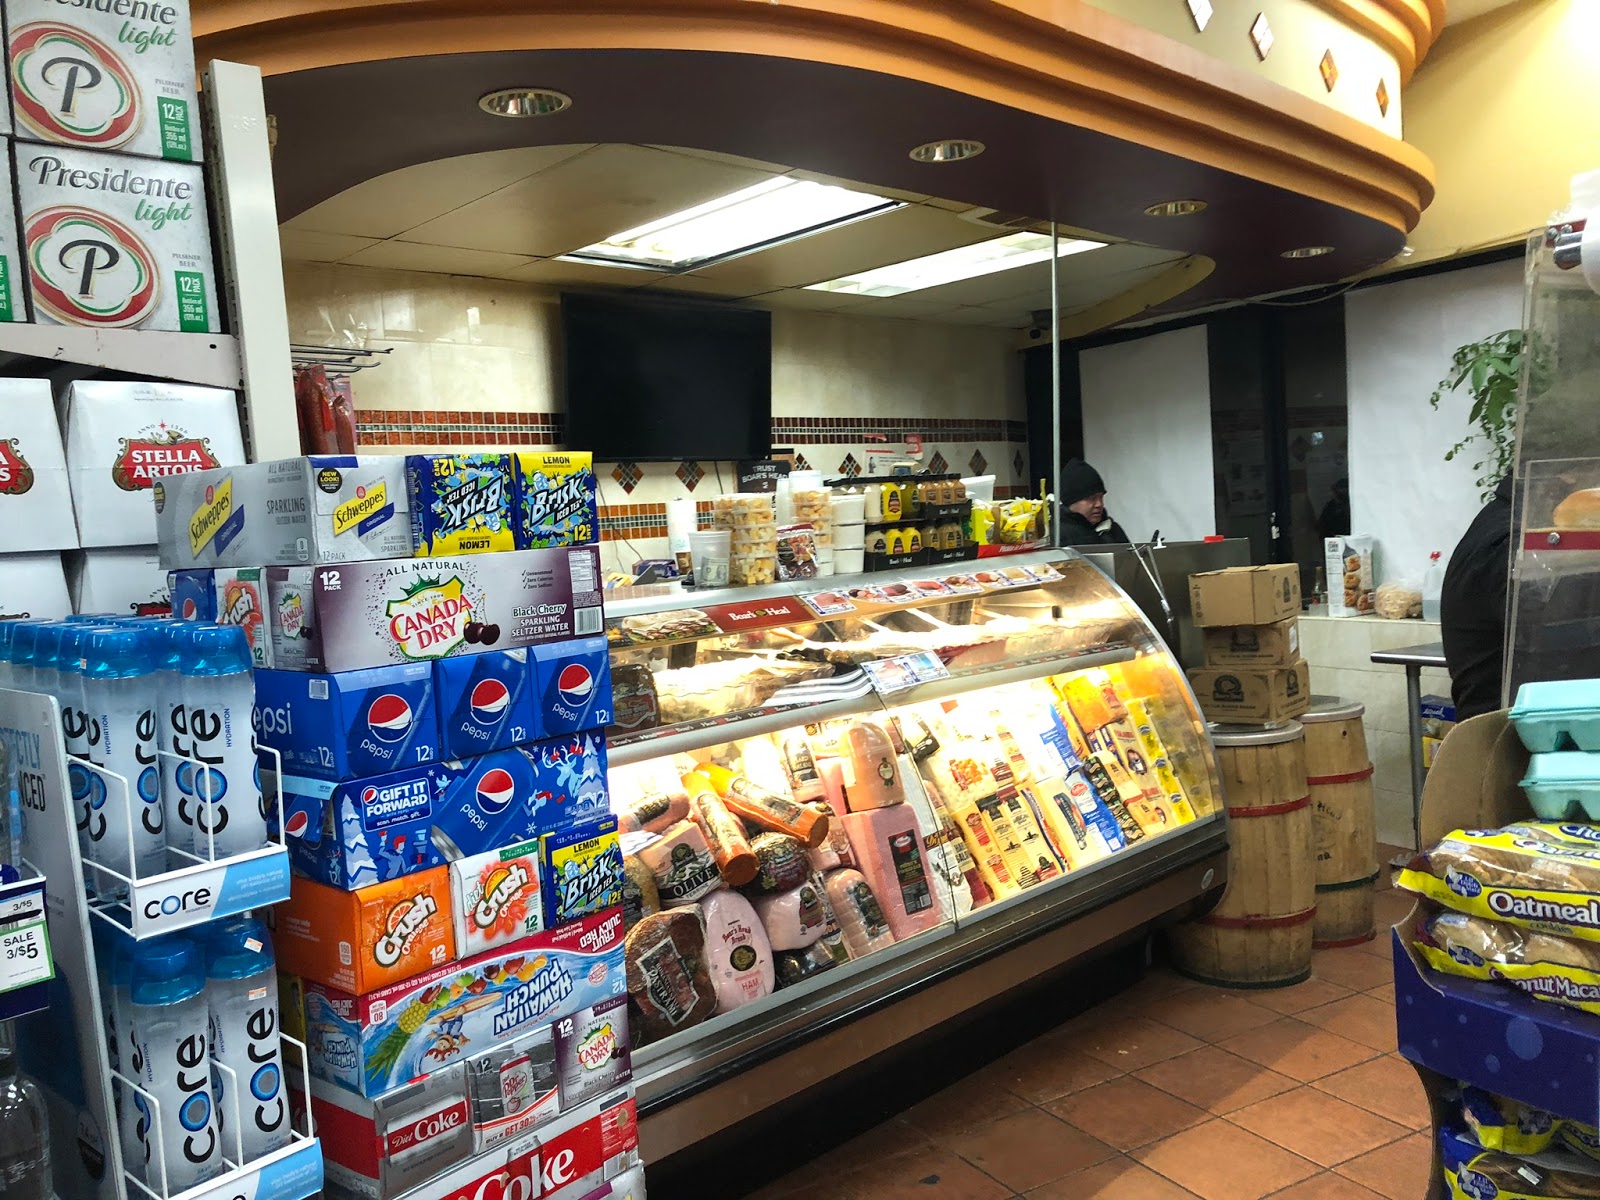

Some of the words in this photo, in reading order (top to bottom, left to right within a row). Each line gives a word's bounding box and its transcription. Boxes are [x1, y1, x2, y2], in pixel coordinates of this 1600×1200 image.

[117, 21, 177, 54] light
[162, 103, 175, 120] 12
[175, 104, 184, 121] PACK
[29, 156, 192, 200] Presidente
[135, 199, 193, 230] light
[180, 276, 192, 292] 12
[192, 278, 202, 292] PACK
[132, 450, 202, 463] STELLA
[542, 456, 570, 465] LEMON
[439, 458, 455, 477] 12
[742, 472, 767, 483] BOAR'S
[460, 481, 475, 495] ICED
[266, 498, 306, 514] SPARKLING
[336, 491, 384, 530] Schweppes
[556, 508, 569, 520] ICED
[190, 490, 230, 548] Schweppes
[574, 525, 586, 542] 12
[381, 544, 408, 552] SPARKLING
[459, 540, 490, 550] LEMON
[323, 551, 330, 561] 12
[331, 552, 346, 560] PACK
[302, 570, 312, 584] 12
[320, 570, 342, 586] 12
[386, 566, 408, 577] ALL
[412, 562, 465, 571] NATURAL
[280, 606, 304, 624] CANADA
[390, 594, 473, 642] CANADA
[513, 607, 536, 618] Black
[537, 604, 566, 614] Cherry
[728, 610, 755, 621] Boar's
[767, 606, 791, 616] Head
[286, 622, 300, 632] DRY
[512, 626, 543, 636] SELTZER
[544, 623, 569, 632] WATER
[520, 615, 560, 626] SPARKLING
[416, 618, 456, 650] DRY
[253, 648, 263, 660] 12
[254, 702, 293, 740] epsi
[552, 703, 578, 722] pepsi
[595, 710, 606, 724] 12
[102, 714, 112, 755] HYDRATION
[224, 708, 232, 748] HYDRATION
[461, 722, 492, 740] pepsi
[510, 726, 522, 742] 12
[318, 746, 332, 768] 12
[360, 738, 394, 760] pepsi
[416, 746, 430, 761] 12
[135, 709, 164, 835] core
[190, 708, 228, 835] core
[380, 785, 410, 802] GIFT
[413, 782, 426, 794] IT
[592, 792, 604, 809] 12
[367, 794, 428, 817] FORWARD
[460, 804, 488, 831] pepsi
[573, 838, 600, 853] LEMON
[673, 868, 714, 897] OLIVE
[474, 864, 530, 929] Crush
[590, 884, 603, 900] ICED
[608, 892, 617, 906] 12
[13, 900, 33, 911] 3/$5
[144, 888, 211, 919] core
[1490, 892, 1599, 924] Oatmeal
[374, 894, 437, 968] Crush
[524, 915, 538, 929] 12
[526, 926, 538, 934] PACK
[598, 913, 621, 935] JUICY
[4, 932, 34, 947] SALE
[402, 919, 429, 956] Orange
[579, 928, 598, 947] RED
[592, 930, 615, 952] FRUIT
[722, 927, 737, 943] Boar's
[738, 925, 751, 934] Head
[7, 942, 39, 960] 3/$5
[430, 945, 446, 960] 12
[503, 958, 564, 1010] PUNCH
[612, 980, 625, 993] 12
[647, 966, 677, 1016] PASTRAMI
[742, 978, 759, 991] HAM
[494, 969, 573, 1036] HAWAIIAN
[374, 1012, 383, 1022] 80
[216, 1014, 225, 1053] HYDRATION
[558, 1019, 573, 1034] 12
[561, 1030, 573, 1038] PACK
[327, 1038, 350, 1052] PUNCH
[578, 1032, 615, 1064] CANADA
[591, 1044, 609, 1064] DRY
[143, 1042, 153, 1082] HYDRATION
[324, 1050, 357, 1069] HAWAIIAN
[476, 1058, 492, 1072] 12
[246, 1007, 284, 1133] core
[616, 1069, 630, 1080] WATER
[504, 1076, 526, 1098] Pepper
[176, 1033, 216, 1164] core
[392, 1132, 413, 1148] Diet
[414, 1112, 459, 1140] Coke
[505, 1124, 520, 1136] GET
